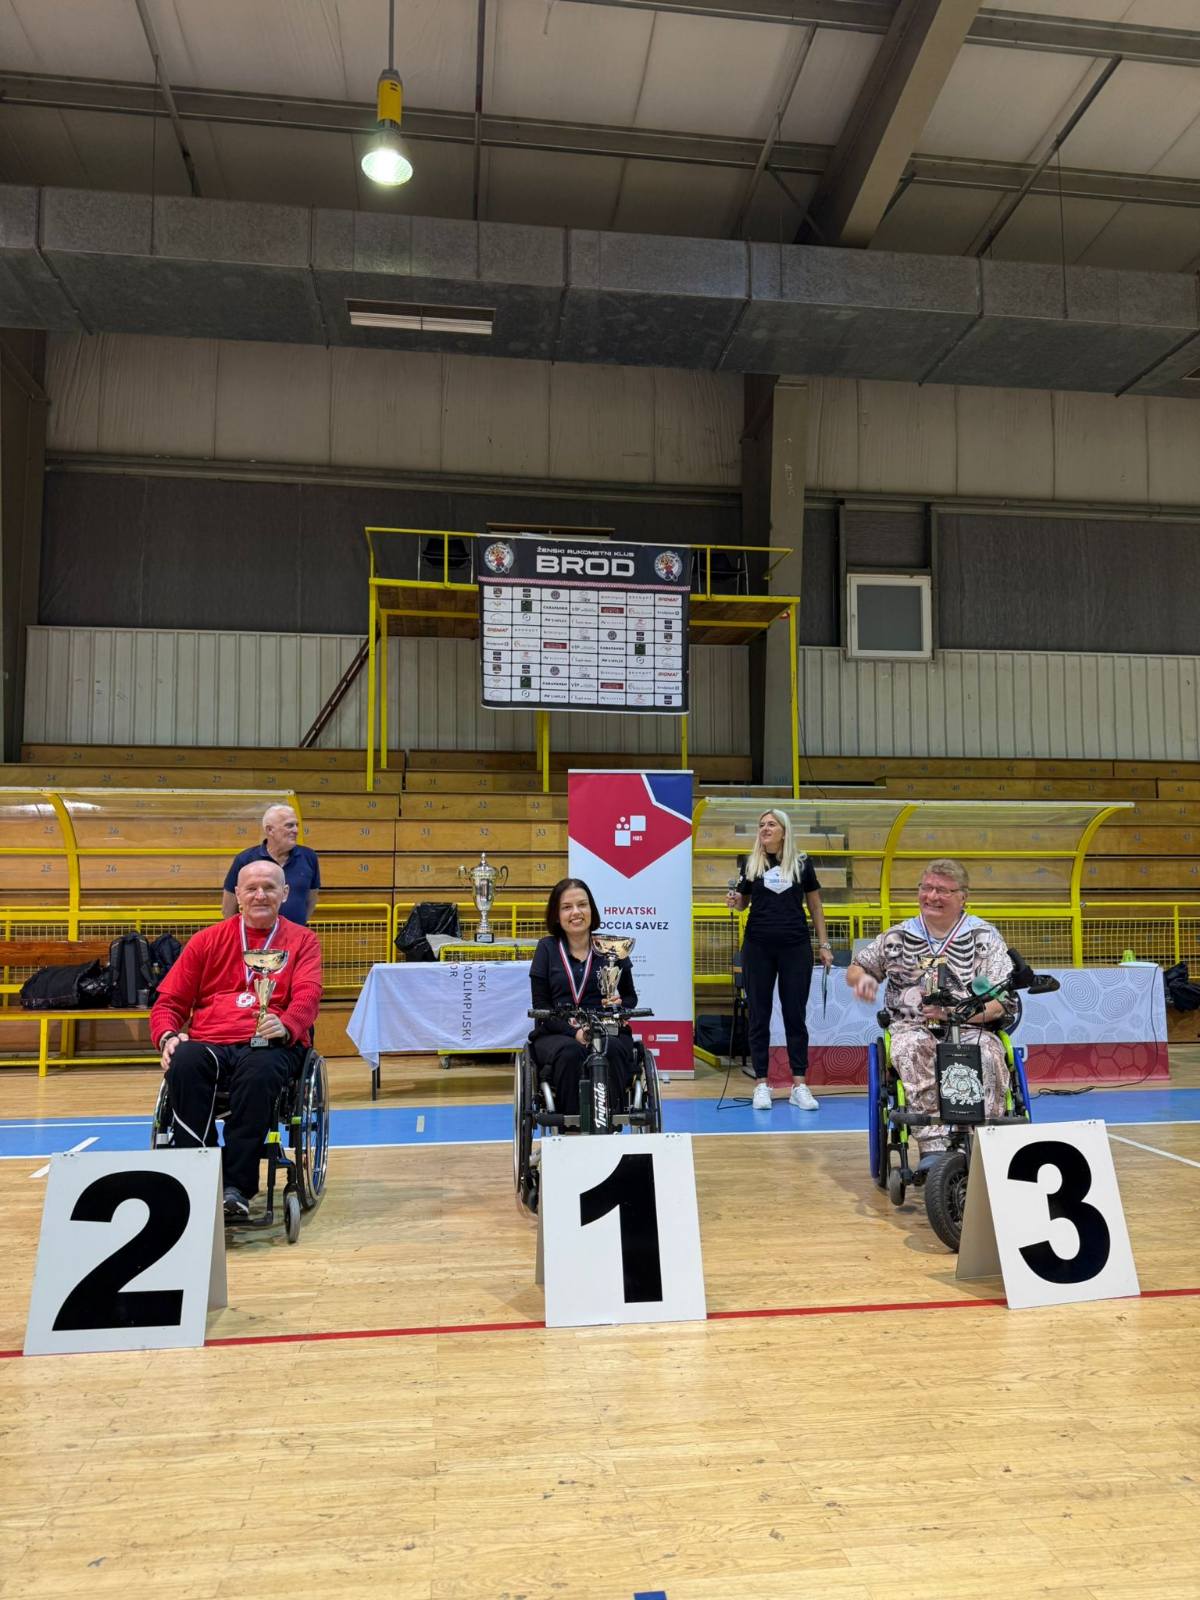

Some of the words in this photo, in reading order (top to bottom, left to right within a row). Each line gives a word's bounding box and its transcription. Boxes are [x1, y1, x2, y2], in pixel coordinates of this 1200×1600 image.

[536, 555, 635, 577] BROD
[367, 800, 378, 810] 30
[359, 827, 371, 837] 30
[421, 828, 432, 838] 31
[479, 828, 490, 838] 32
[535, 829, 547, 839] 33
[41, 863, 53, 872] 25
[105, 863, 118, 873] 26
[168, 863, 182, 872] 27
[357, 863, 370, 873] 30
[419, 864, 432, 874] 31
[536, 863, 548, 873] 33
[603, 906, 657, 916] HRVATSKI
[599, 921, 633, 931] OCCIA
[635, 921, 670, 931] SAVEZ
[449, 965, 458, 977] OR
[462, 965, 472, 1041] AOLIMPIJSKI
[594, 1082, 607, 1128] Triride
[1008, 1141, 1110, 1284] 3
[580, 1154, 662, 1304] 1
[53, 1170, 191, 1331] 2
